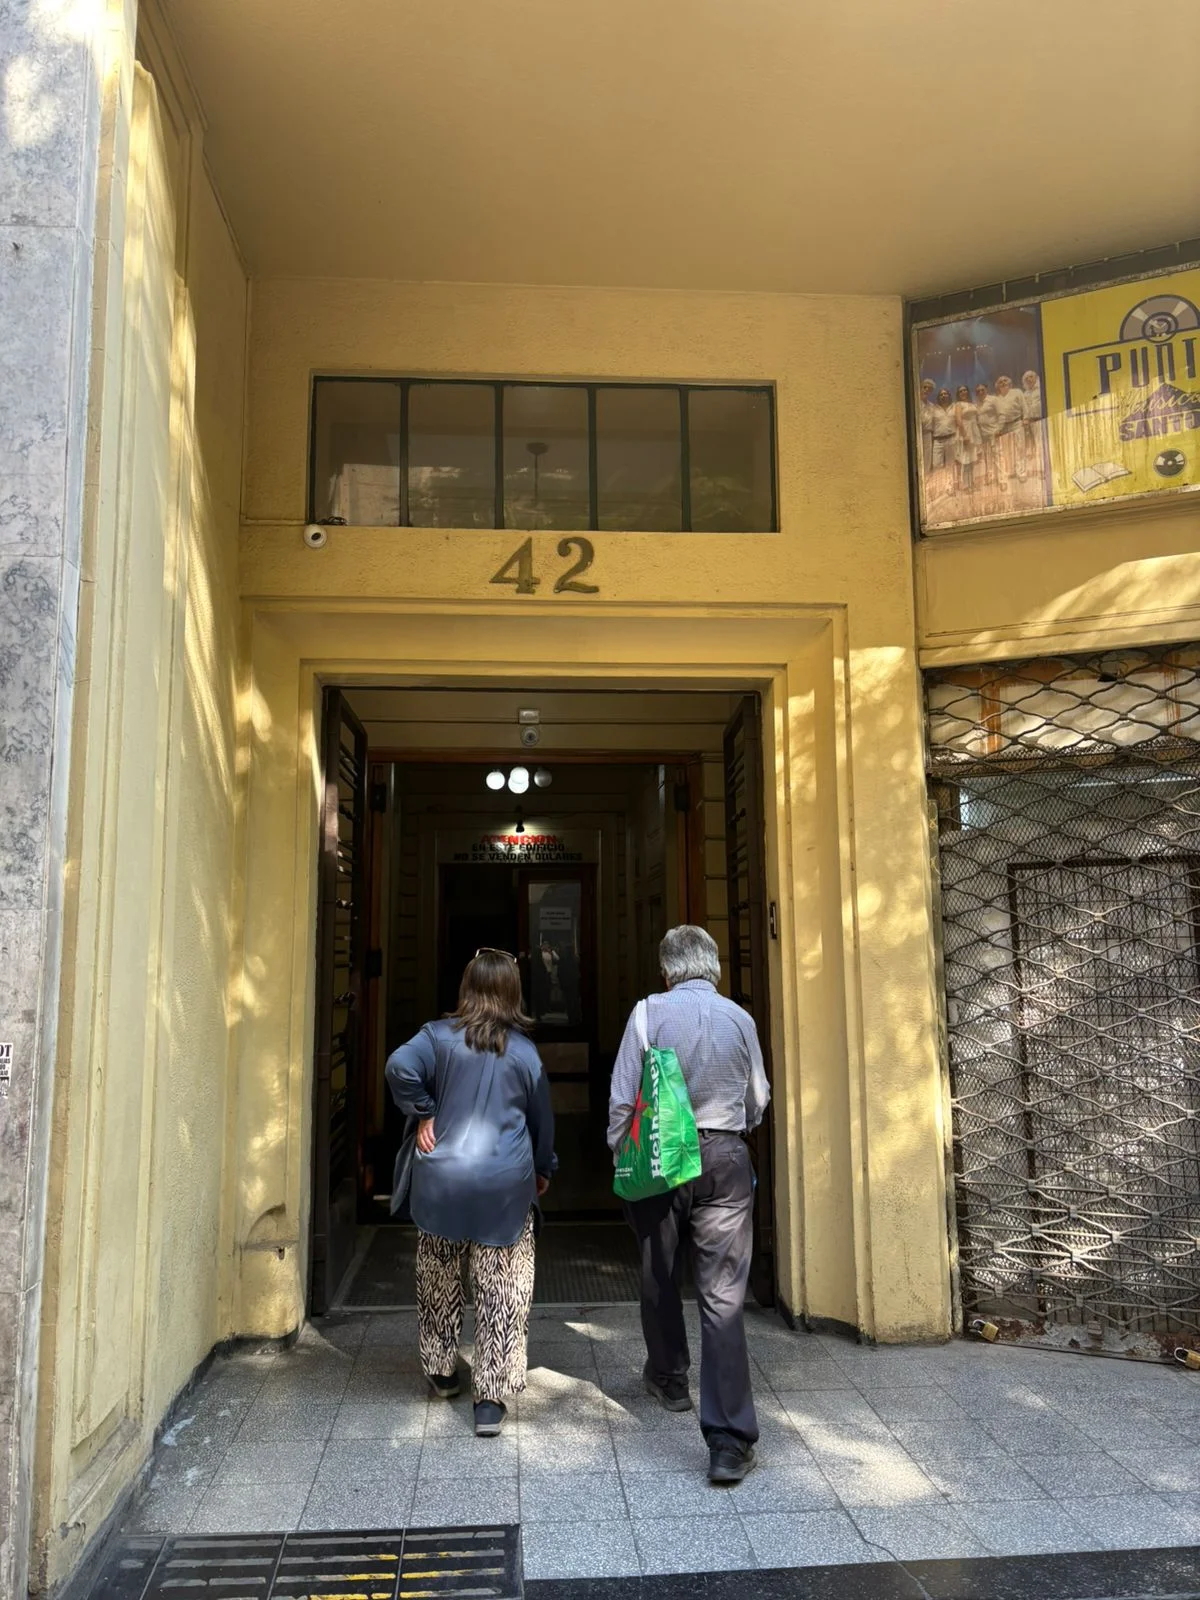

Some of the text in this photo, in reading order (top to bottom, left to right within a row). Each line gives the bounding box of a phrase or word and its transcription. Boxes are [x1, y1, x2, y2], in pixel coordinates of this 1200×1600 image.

[489, 536, 600, 594] 42
[454, 853, 583, 861] NO SE VENDEN DOLARES
